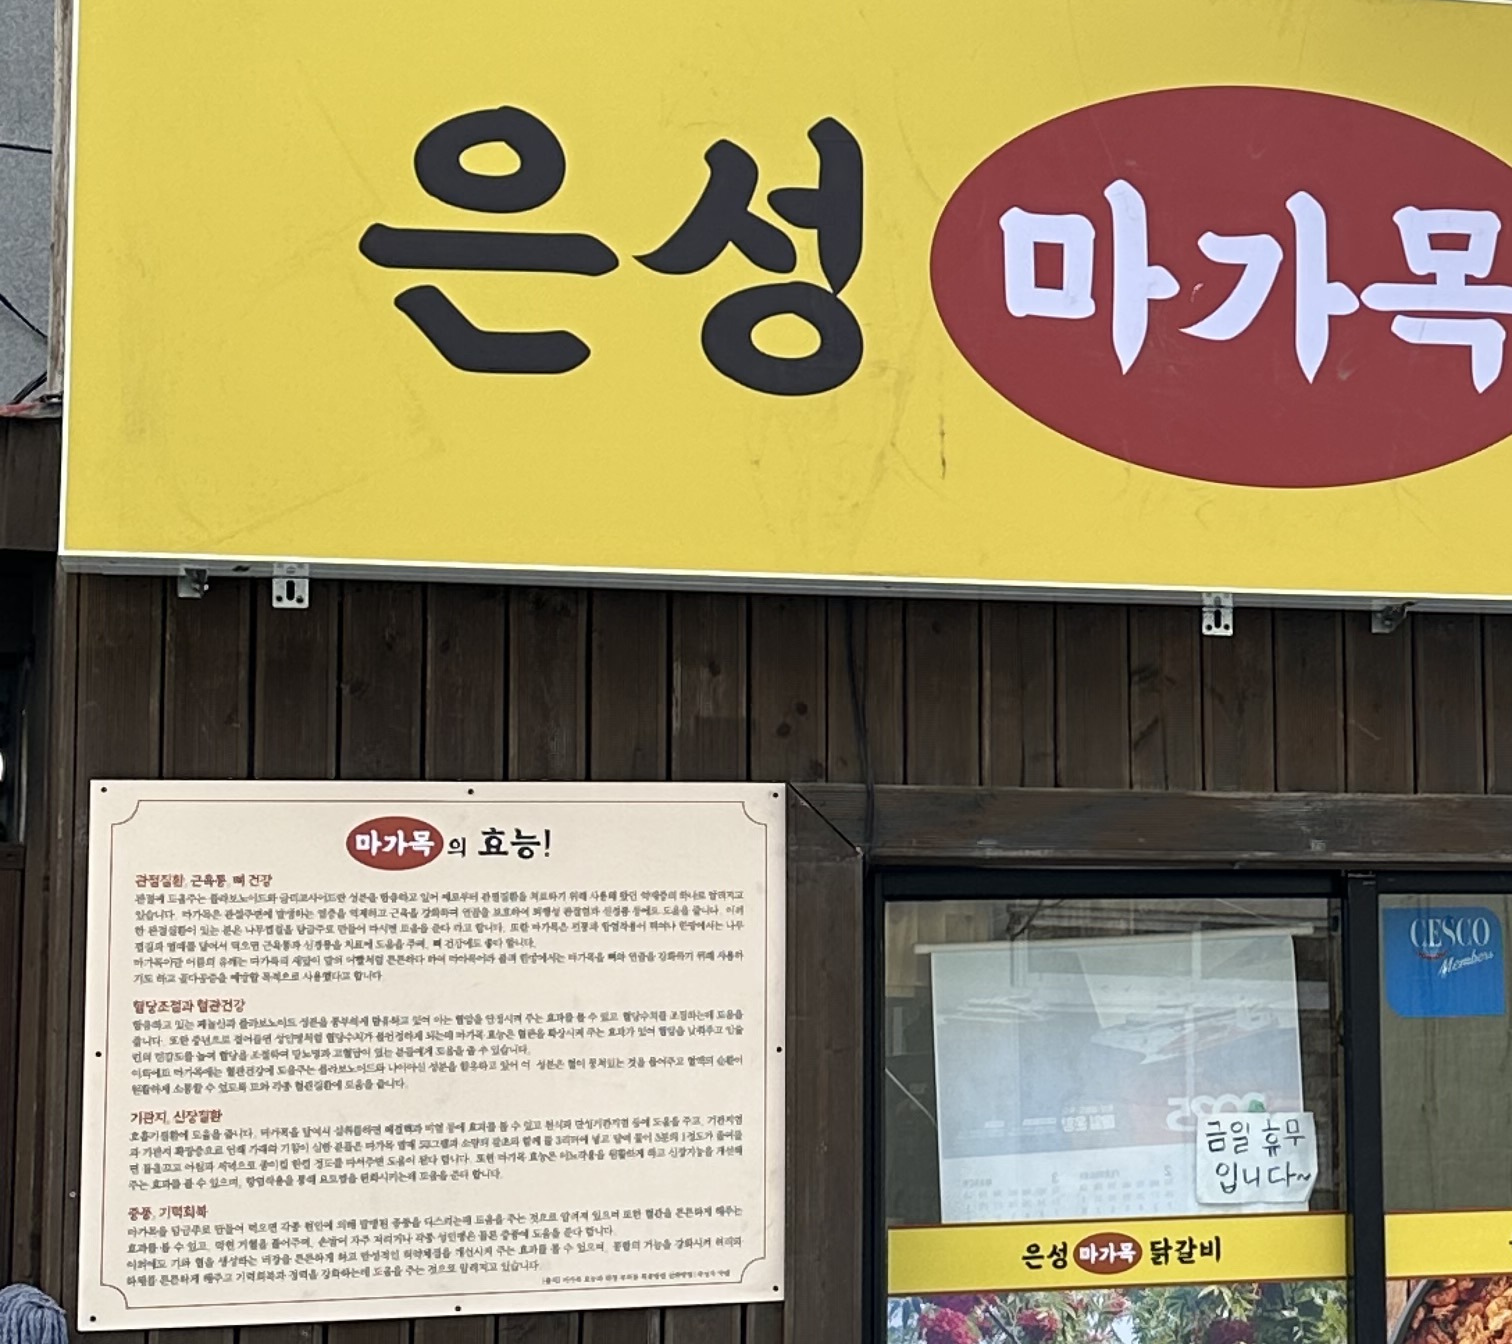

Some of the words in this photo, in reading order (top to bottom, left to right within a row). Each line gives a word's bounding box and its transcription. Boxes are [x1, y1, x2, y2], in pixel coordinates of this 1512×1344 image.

[359, 106, 864, 396] 은성
[354, 831, 435, 856] 마가목
[448, 836, 466, 858] 의
[478, 827, 551, 860] 효능!
[248, 872, 273, 888] 건강
[1410, 918, 1490, 947] CESCO
[1206, 1120, 1249, 1155] 금일
[1261, 1117, 1305, 1157] 휴무
[1021, 1241, 1069, 1270] 은성
[1079, 1242, 1137, 1264] 마가목
[1149, 1236, 1222, 1266] 닭갈비
